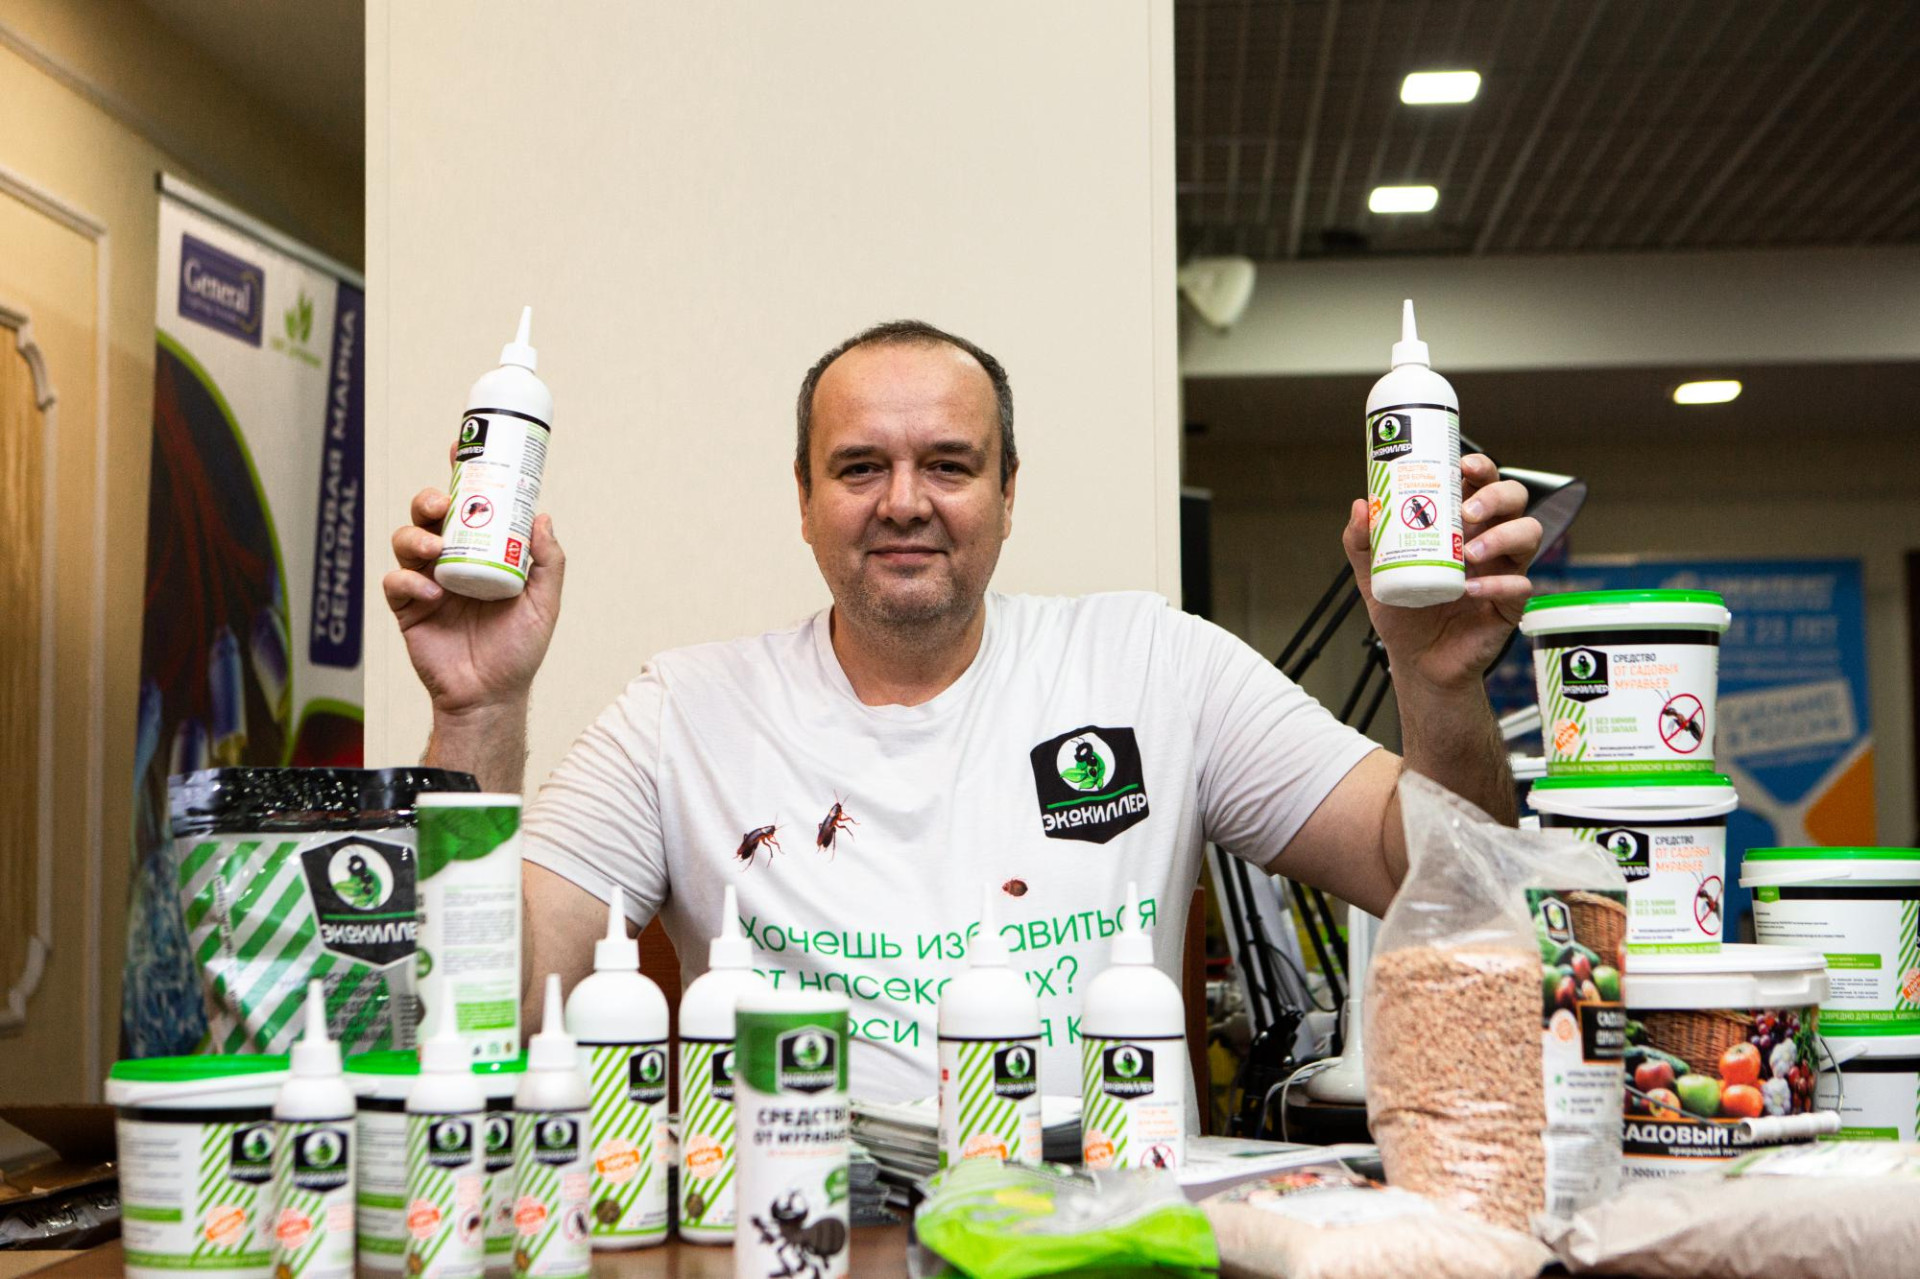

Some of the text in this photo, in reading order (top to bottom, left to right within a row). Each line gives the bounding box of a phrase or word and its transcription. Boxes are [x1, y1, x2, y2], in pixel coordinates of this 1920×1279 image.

[183, 257, 253, 316] General
[313, 310, 358, 641] ТОРГОВАЯ МАРКА
[328, 479, 360, 645] GENERAL
[1613, 653, 1656, 663] СРЕДСТВО
[1614, 667, 1626, 676] ОТ
[1042, 792, 1147, 832] ЭКОКИЛЛЕР
[1655, 835, 1694, 845] СРЕДСТВО
[321, 921, 418, 944] ЭКОКИЛЛЕ
[739, 916, 903, 959] Хочешь
[799, 955, 1078, 1005] насекх?
